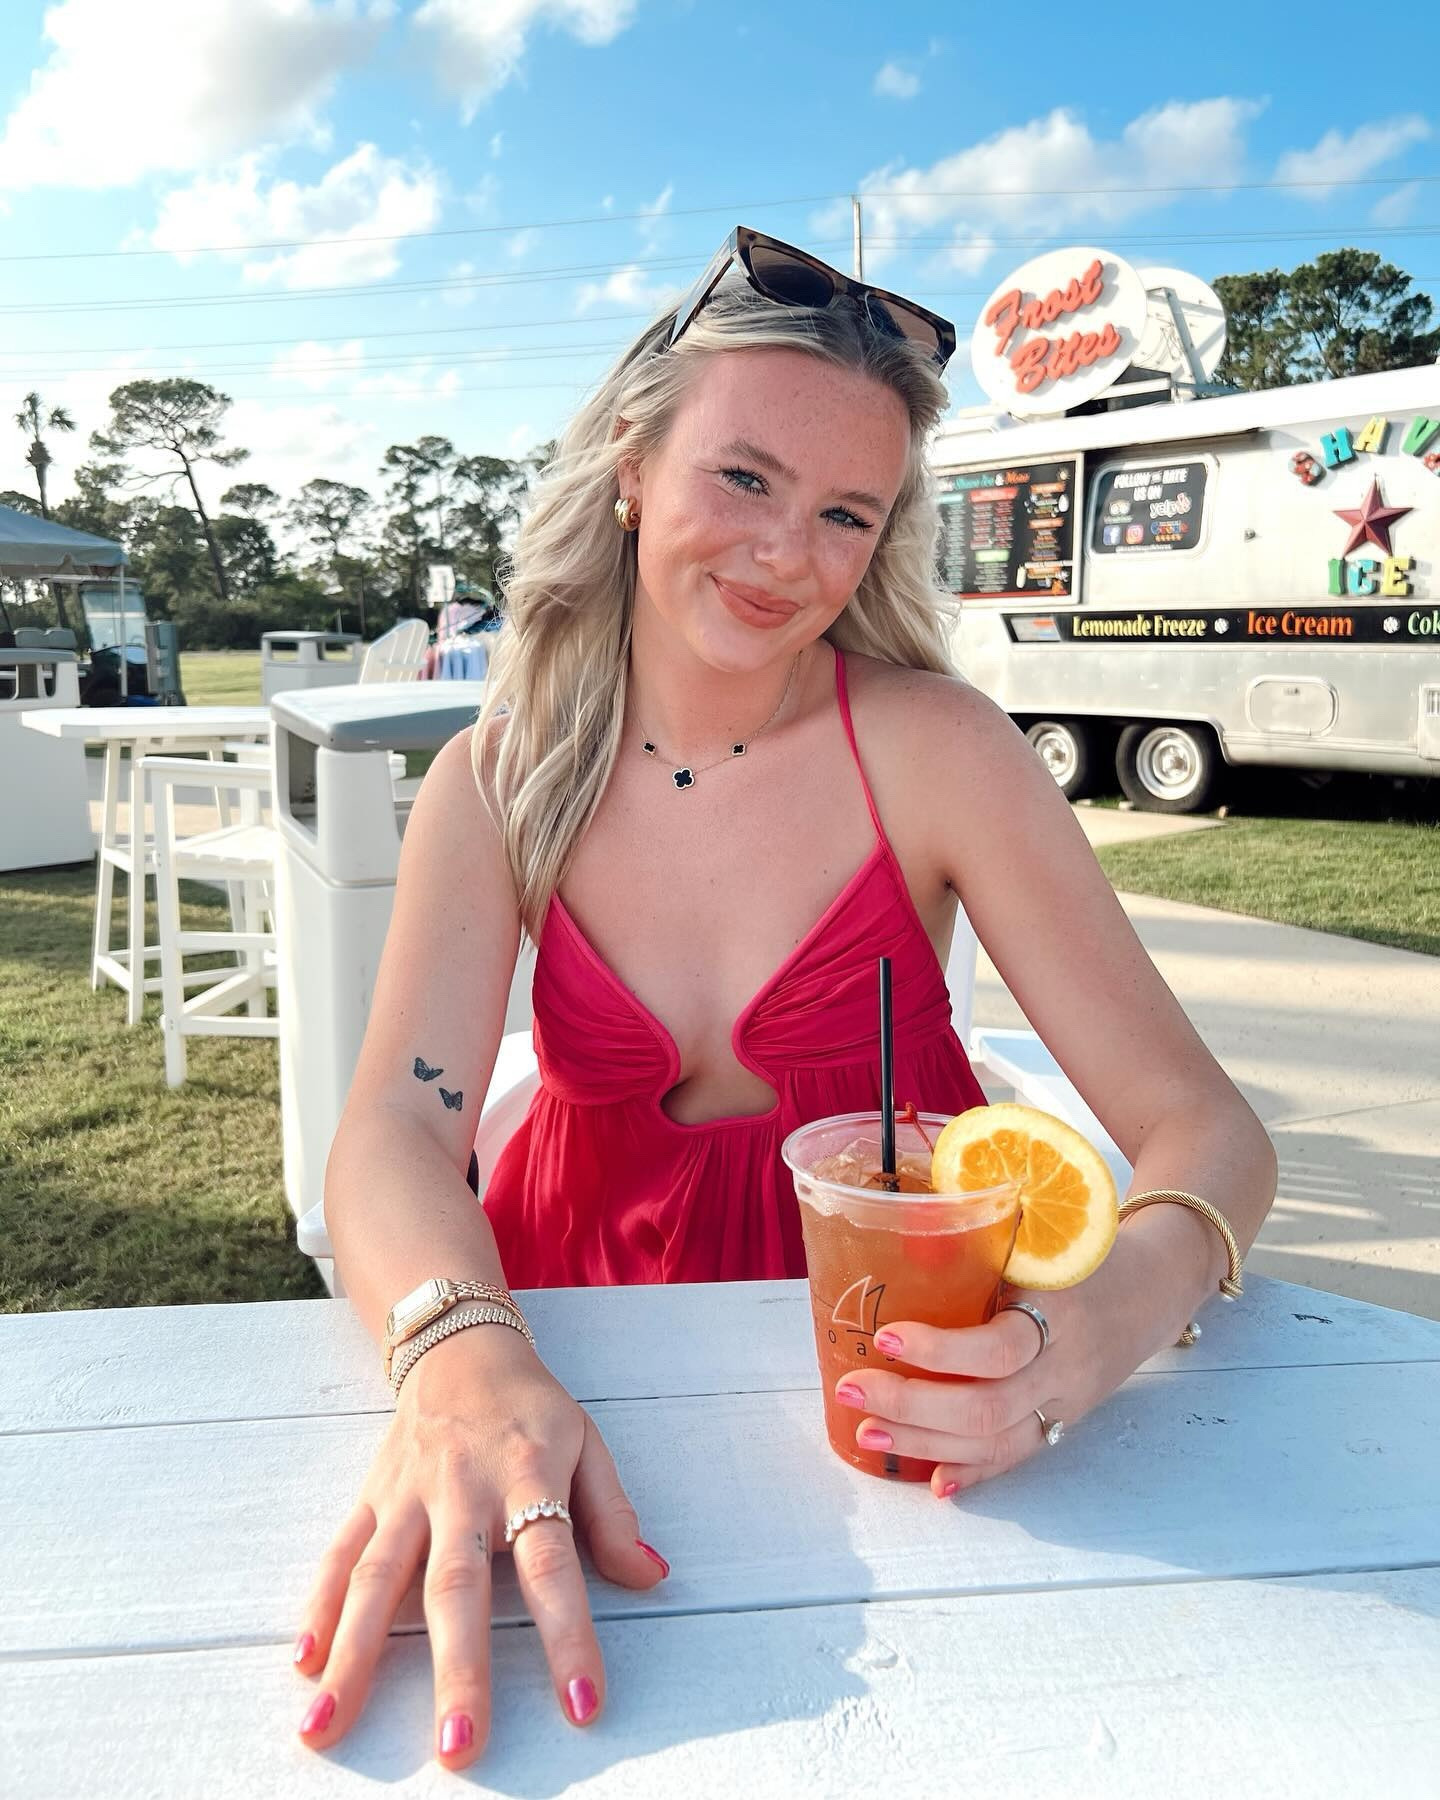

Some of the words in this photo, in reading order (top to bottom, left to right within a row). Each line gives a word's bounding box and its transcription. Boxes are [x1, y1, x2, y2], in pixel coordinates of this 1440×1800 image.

[985, 259, 1104, 357] Frost
[1010, 323, 1121, 394] Bites
[1328, 558, 1414, 596] ICE
[1072, 613, 1151, 637] Lemonade
[1153, 614, 1207, 637] Freeze
[1247, 610, 1278, 635] Ice
[1281, 610, 1354, 637] Cream
